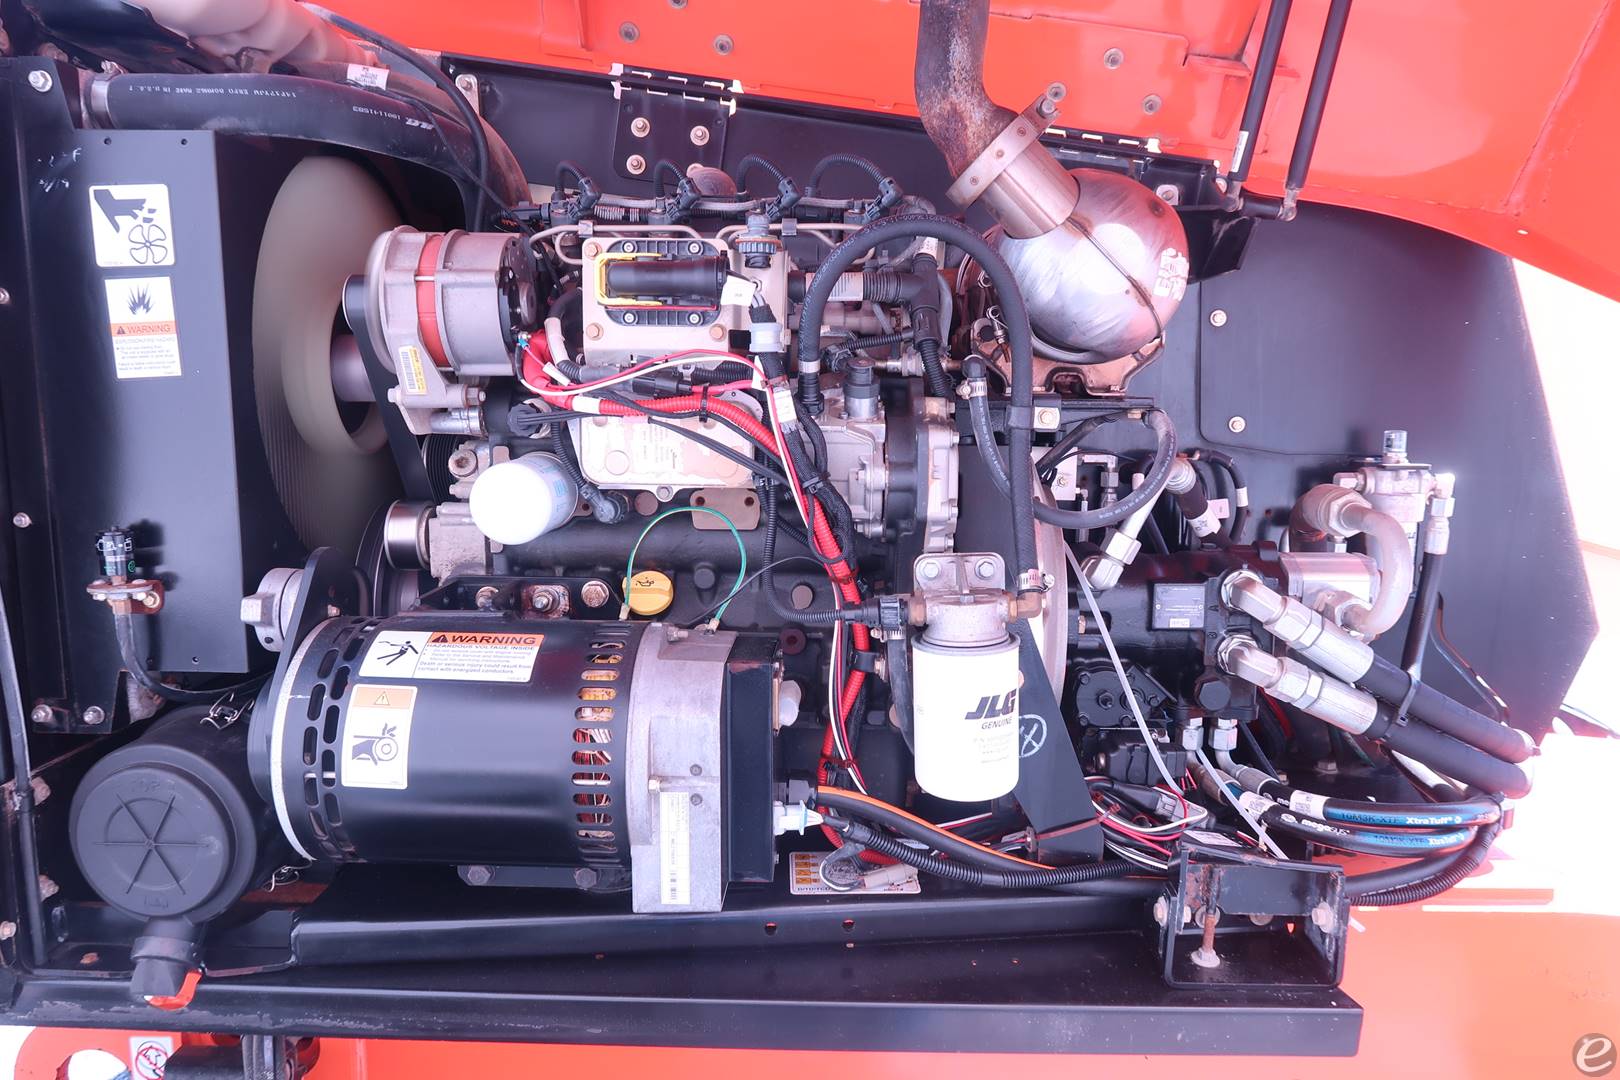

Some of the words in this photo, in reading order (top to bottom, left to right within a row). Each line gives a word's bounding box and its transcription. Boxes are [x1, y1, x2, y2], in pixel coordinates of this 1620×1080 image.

[127, 323, 171, 335] WARNING
[451, 635, 536, 645] WARNING
[964, 688, 1017, 720] JLG
[981, 716, 1012, 730] GENUINE
